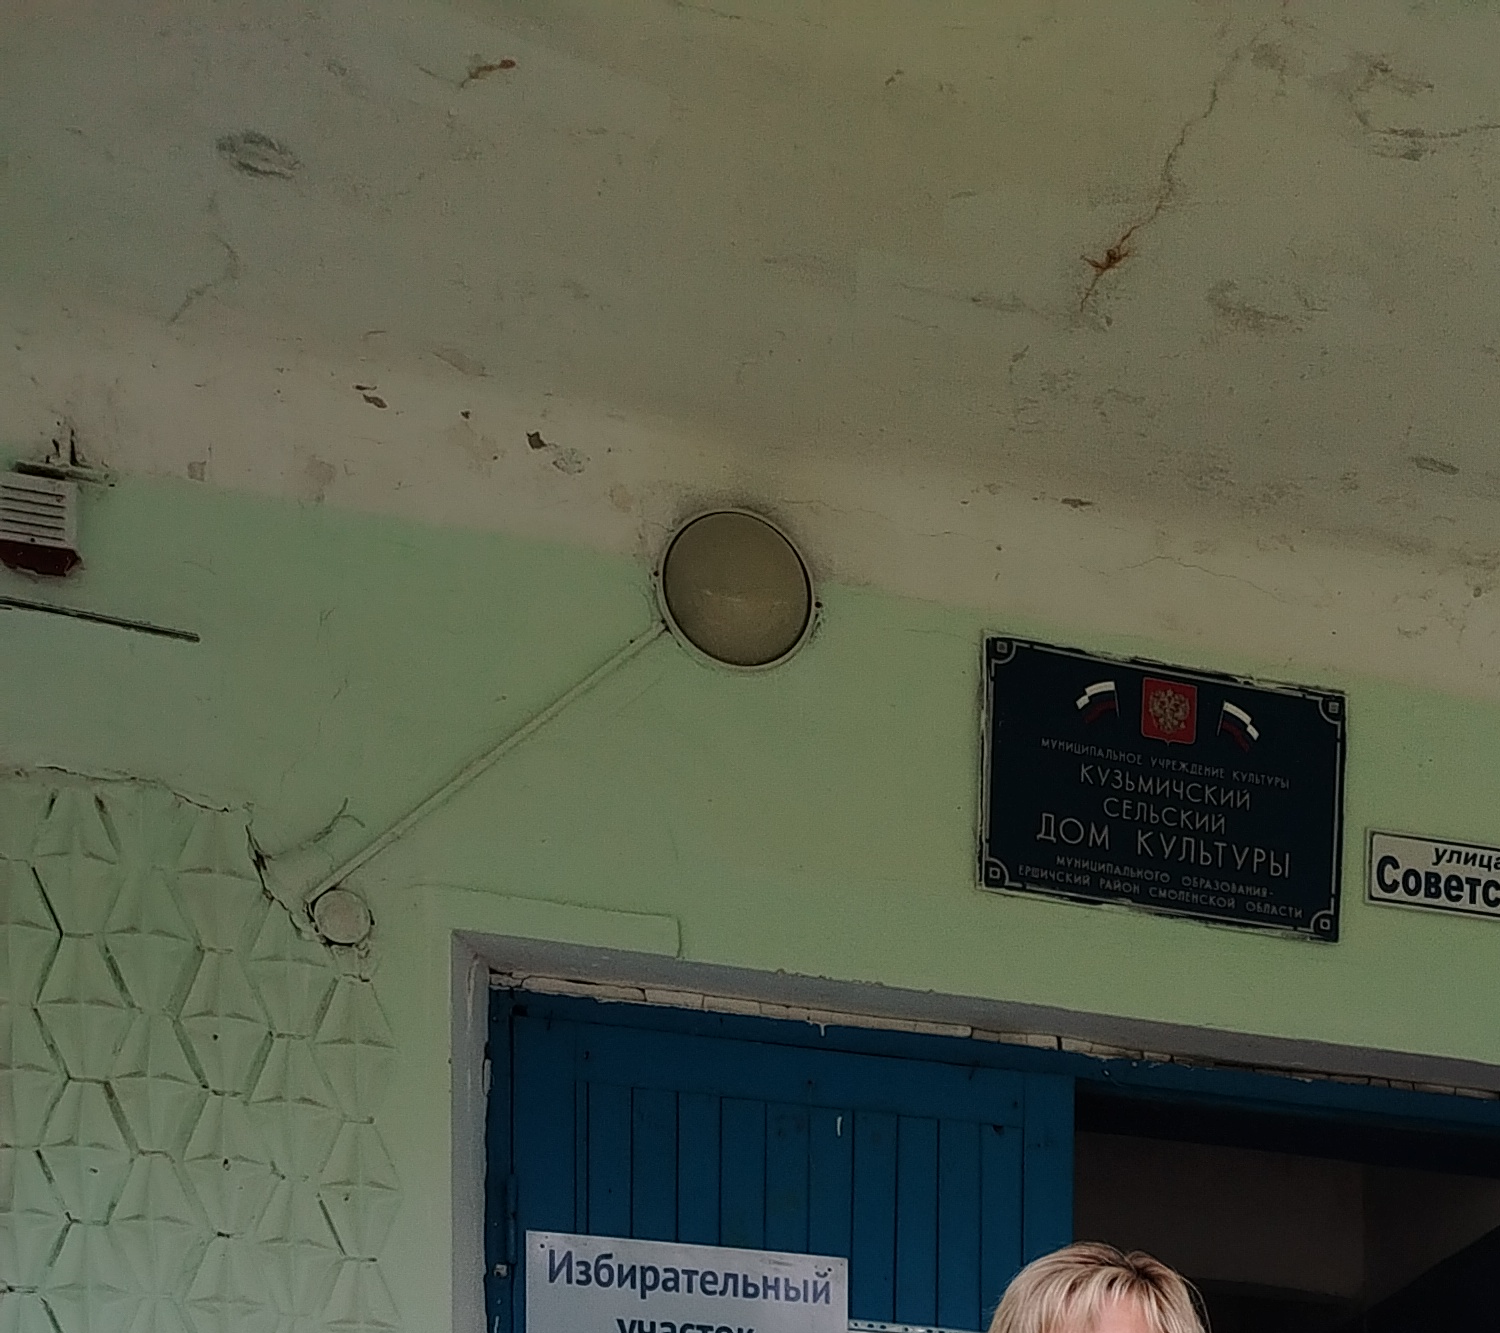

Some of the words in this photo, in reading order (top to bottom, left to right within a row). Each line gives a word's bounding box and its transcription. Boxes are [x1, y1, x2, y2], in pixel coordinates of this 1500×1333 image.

[1041, 738, 1143, 766] МУНИЦИПАЛЬНОЕ
[1151, 757, 1225, 780] УЧРЕЖДЕНИЕ
[1233, 769, 1290, 789] КУЛЬТУРЫ
[1080, 763, 1250, 811] КУЗЬМИЧСКИЙ
[1103, 797, 1226, 836] СЕЛЬСКИЙ
[1036, 813, 1110, 850] ДОМ
[1137, 830, 1290, 878] КУЛЬТУРЫ
[1057, 855, 1170, 884] МУНИЦИПАЛЬНОГО
[1018, 864, 1091, 887] ЕРШИЧСКИЙ
[1100, 876, 1140, 895] РАЙОН
[1149, 886, 1236, 909] СМОЛЕНСКОЙ
[1245, 901, 1303, 919] ОБЛАСТИ
[548, 1248, 831, 1305] Избирательный
